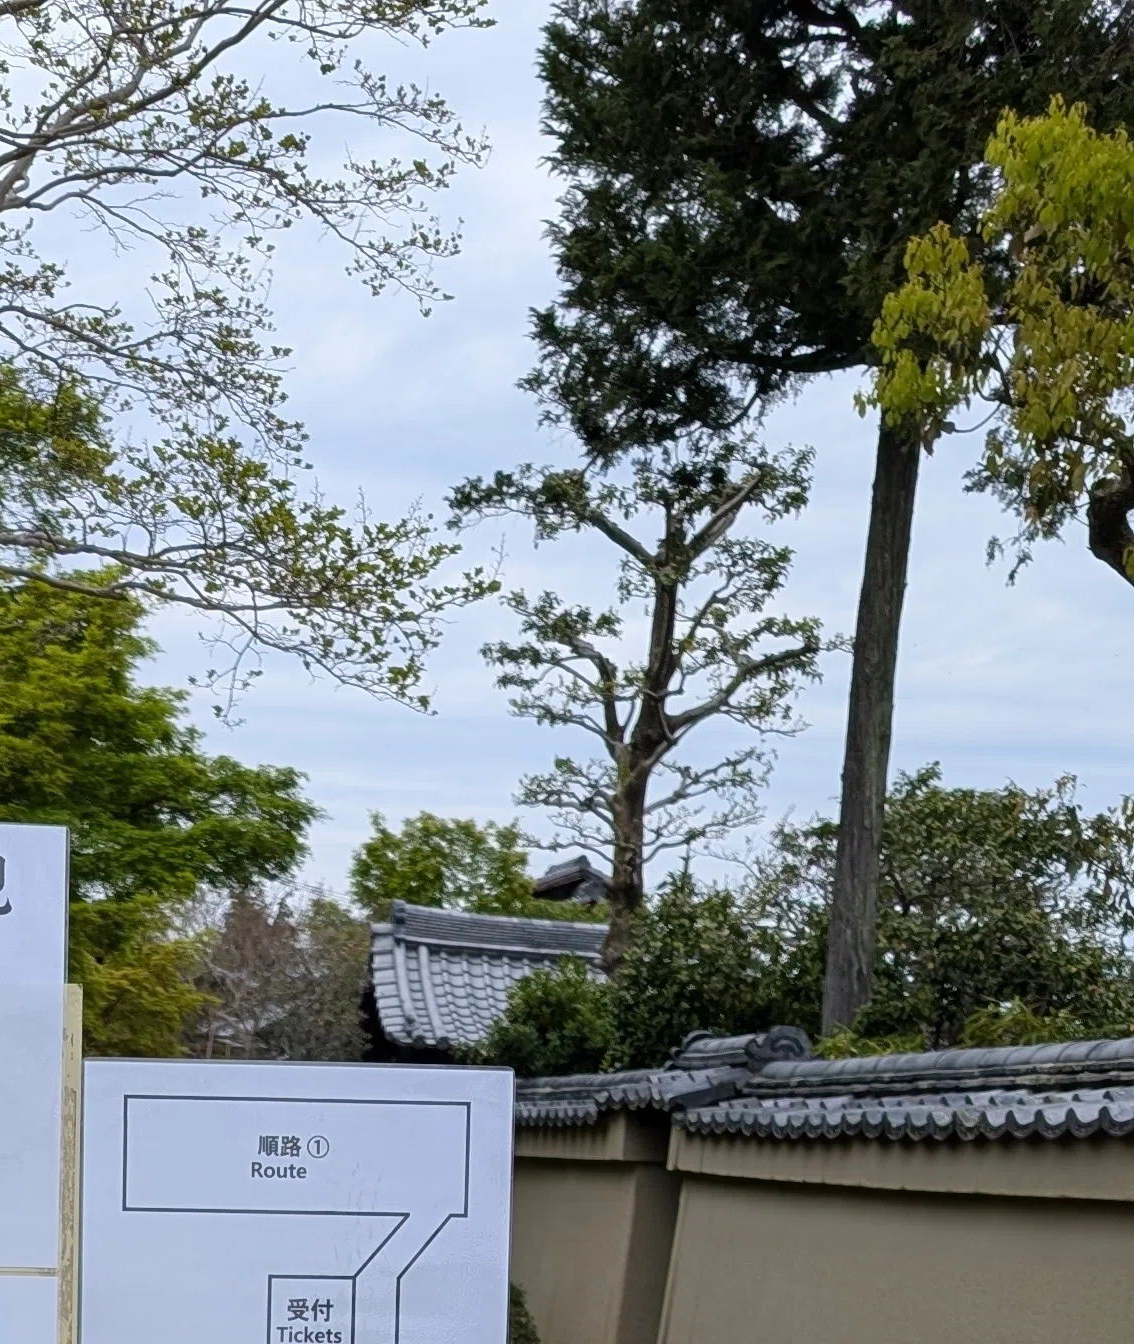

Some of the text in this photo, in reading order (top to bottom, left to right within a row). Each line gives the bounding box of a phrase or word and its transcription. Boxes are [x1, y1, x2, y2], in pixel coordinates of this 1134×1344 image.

[258, 1136, 301, 1157] 順路
[251, 1162, 307, 1178] Route
[288, 1299, 334, 1322] 受付
[277, 1326, 342, 1343] Tickets
